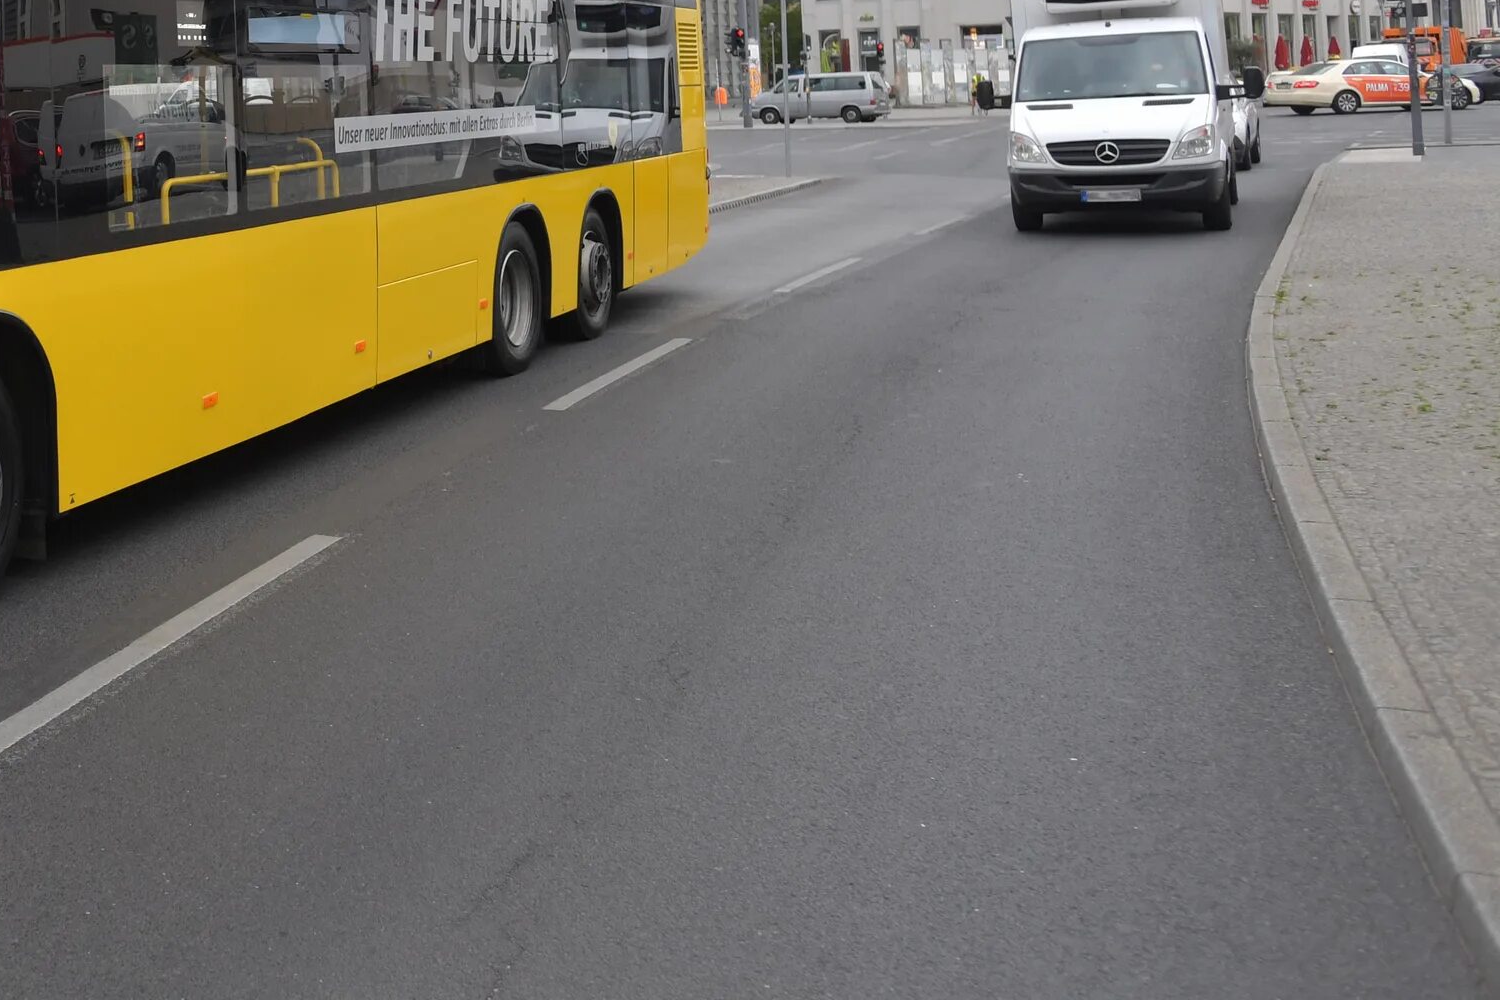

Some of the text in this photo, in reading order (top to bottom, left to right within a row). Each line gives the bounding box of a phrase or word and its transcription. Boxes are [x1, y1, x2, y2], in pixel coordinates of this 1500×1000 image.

[338, 125, 363, 145] Unser
[364, 127, 388, 142] neuer
[390, 117, 448, 140] Innovationsbus:
[449, 116, 461, 134] mit
[462, 115, 478, 132] allen
[479, 114, 498, 131] Extras
[500, 113, 516, 129] durch
